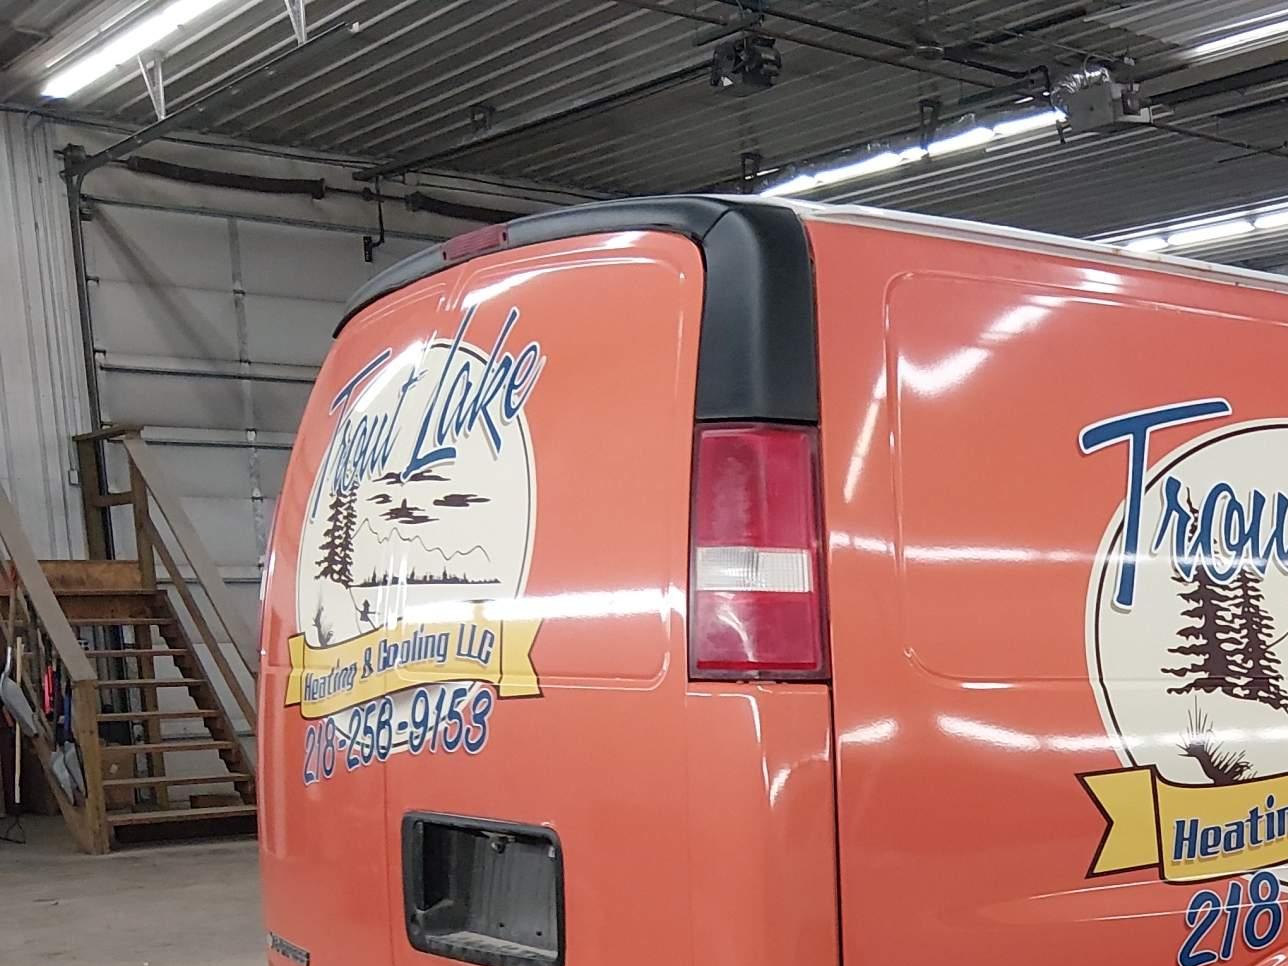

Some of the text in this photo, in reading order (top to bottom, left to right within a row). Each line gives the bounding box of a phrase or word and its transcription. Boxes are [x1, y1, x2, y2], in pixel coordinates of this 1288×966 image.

[311, 304, 537, 520] Trout Lake
[304, 623, 495, 701] Heating & Cooling LLC
